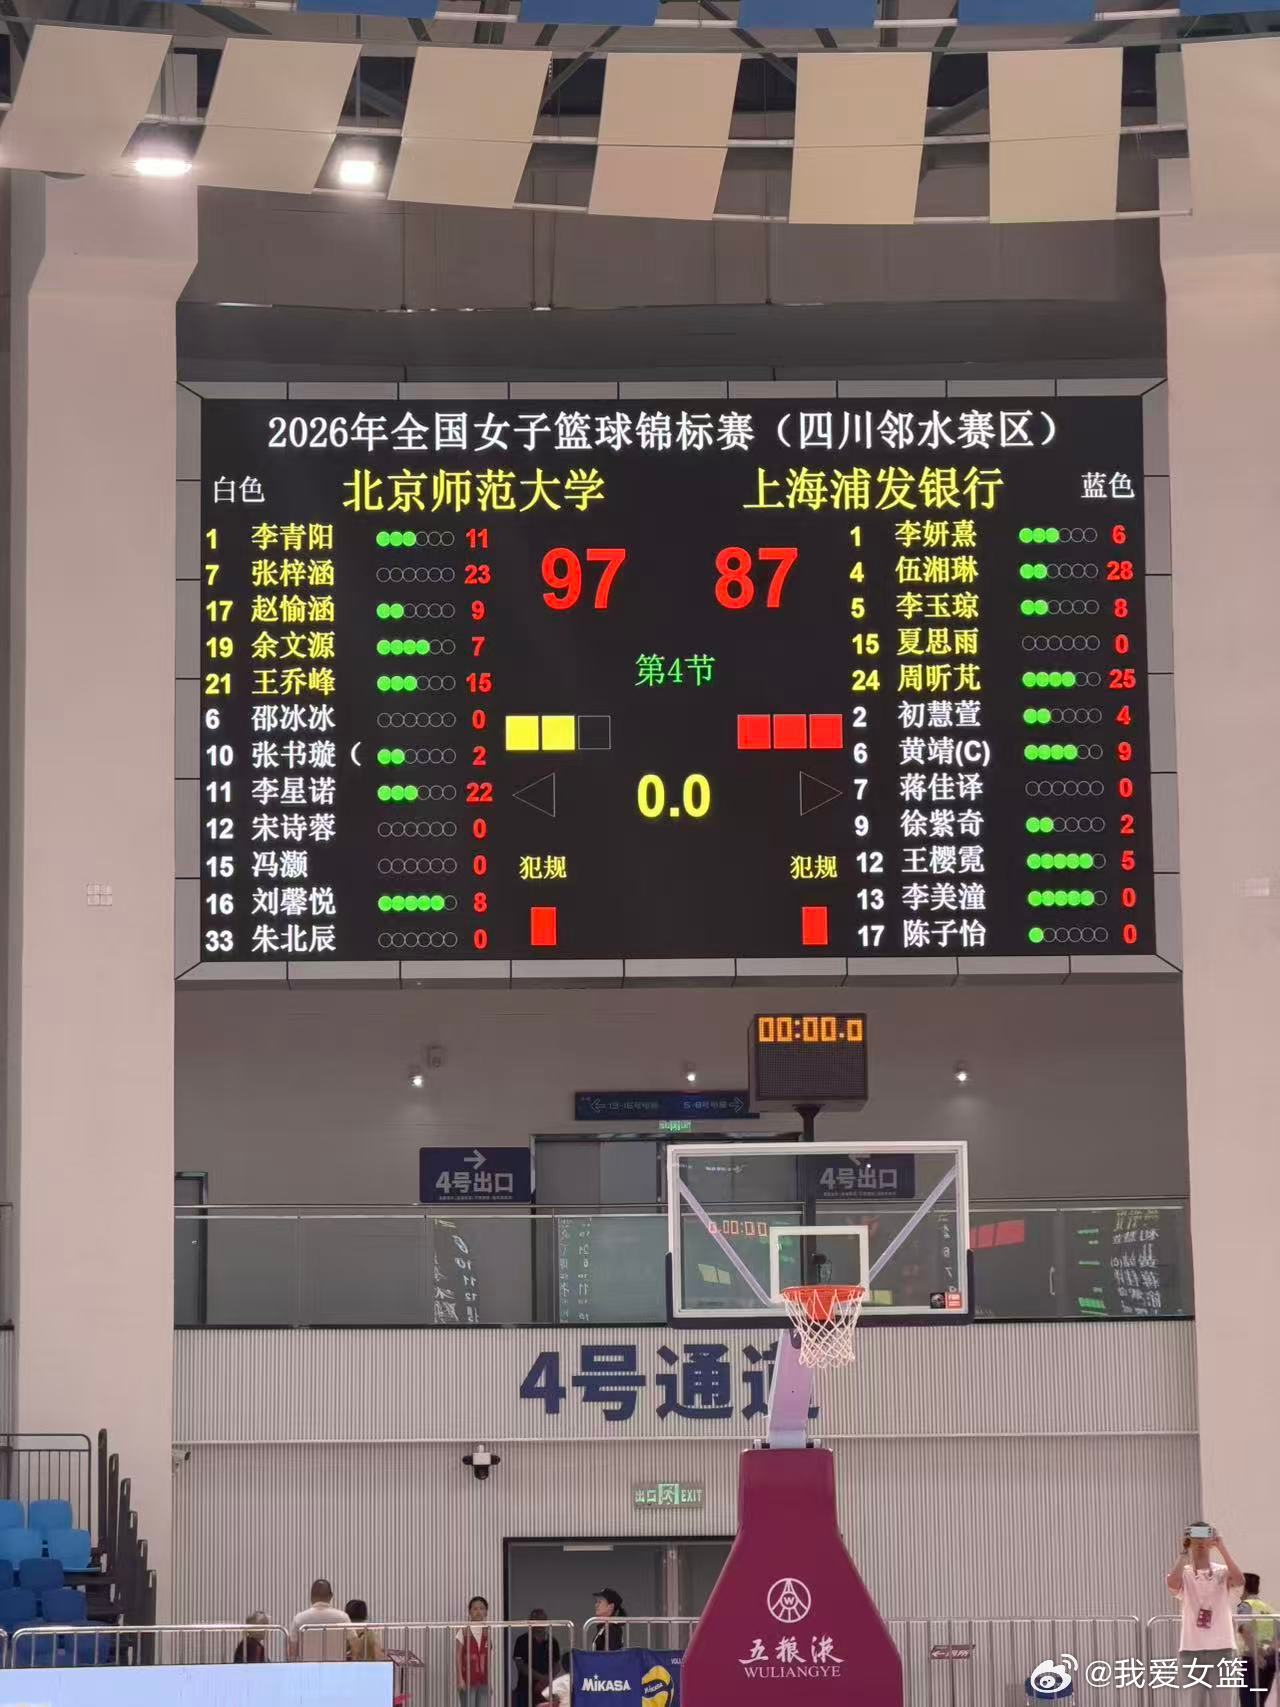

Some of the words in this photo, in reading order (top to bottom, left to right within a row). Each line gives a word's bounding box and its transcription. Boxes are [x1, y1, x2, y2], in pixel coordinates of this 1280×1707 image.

[267, 408, 1058, 454] 2026年全国女子篮球锦标赛（四川邻水赛区）
[213, 475, 266, 504] 白色
[342, 467, 605, 513] 北京师范大学
[742, 465, 1005, 511] 上海浦发银行
[1080, 471, 1136, 500] 蓝色
[205, 528, 217, 550] 1
[250, 522, 334, 552] 李青阳
[465, 527, 489, 550] 11
[849, 525, 861, 547] 1
[894, 518, 978, 549] 李妍熹
[1111, 524, 1127, 545] 6
[204, 563, 220, 586] 7
[251, 557, 335, 588] 张梓涵
[463, 563, 492, 586] 23
[541, 547, 627, 612] 97
[714, 546, 799, 611] 87
[849, 561, 865, 583] 4
[894, 554, 980, 584] 伍湘琳
[1106, 560, 1134, 581] 28
[205, 599, 234, 622] 17
[250, 593, 335, 624] 赵愉涵
[471, 600, 486, 621] 9
[850, 597, 866, 619] 5
[895, 590, 980, 620] 李玉琼
[1114, 598, 1129, 619] 8
[205, 636, 234, 659] 19
[250, 630, 336, 660] 余文源
[471, 635, 486, 658] 7
[851, 632, 880, 656] 15
[896, 626, 980, 656] 夏思雨
[1114, 634, 1129, 655] 0
[204, 672, 231, 695] 21
[251, 666, 337, 696] 王乔峰
[465, 672, 493, 695] 15
[634, 653, 716, 687] 第4节
[851, 669, 881, 692] 24
[897, 662, 982, 693] 周昕芃
[1108, 668, 1137, 690] 25
[204, 707, 221, 730] 6
[250, 703, 337, 733] 邵冰冰
[471, 709, 487, 731] 0
[852, 705, 868, 728] 2
[897, 699, 982, 729] 初慧萱
[1116, 705, 1132, 726] 4
[205, 744, 234, 767] 10
[472, 745, 487, 768] 2
[853, 742, 869, 765] 6
[898, 735, 991, 768] 黄靖(C)
[1117, 741, 1133, 762] 9
[205, 780, 231, 803] 11
[251, 775, 337, 806] 李星诺
[465, 781, 494, 806] 22
[637, 773, 711, 819] 0.0
[853, 778, 869, 801] 7
[899, 772, 984, 802] 蒋佳译
[1118, 777, 1133, 798] 0
[205, 817, 234, 840] 12
[250, 812, 337, 843] 宋诗蓉
[472, 817, 488, 841] 0
[854, 814, 870, 837] 9
[899, 807, 985, 838] 徐紫奇
[1120, 814, 1135, 835] 2
[205, 855, 235, 878] 15
[250, 849, 309, 879] 冯灏
[472, 854, 488, 876] 0
[518, 854, 568, 881] 犯规
[789, 854, 839, 880] 犯规
[856, 851, 884, 874] 12
[901, 844, 986, 875] 王樱霓
[1121, 850, 1136, 871] 5
[205, 892, 235, 916] 16
[250, 886, 337, 917] 刘馨悦
[473, 891, 488, 914] 8
[856, 888, 885, 911] 13
[901, 881, 987, 912] 李美潼
[1121, 887, 1137, 908] 0
[204, 929, 234, 953] 33
[250, 923, 337, 954] 朱北辰
[473, 928, 489, 950] 0
[857, 924, 886, 947] 17
[902, 918, 987, 949] 陈子怡
[1122, 923, 1138, 945] 0
[758, 1016, 863, 1042] 00:00.0
[435, 1171, 513, 1194] 4号出口
[820, 1167, 898, 1190] 4号出口
[634, 1489, 657, 1503] 出口
[681, 1489, 703, 1503] EXIT
[738, 1635, 844, 1664] 五粮液
[744, 1666, 841, 1679] WULIANGYE
